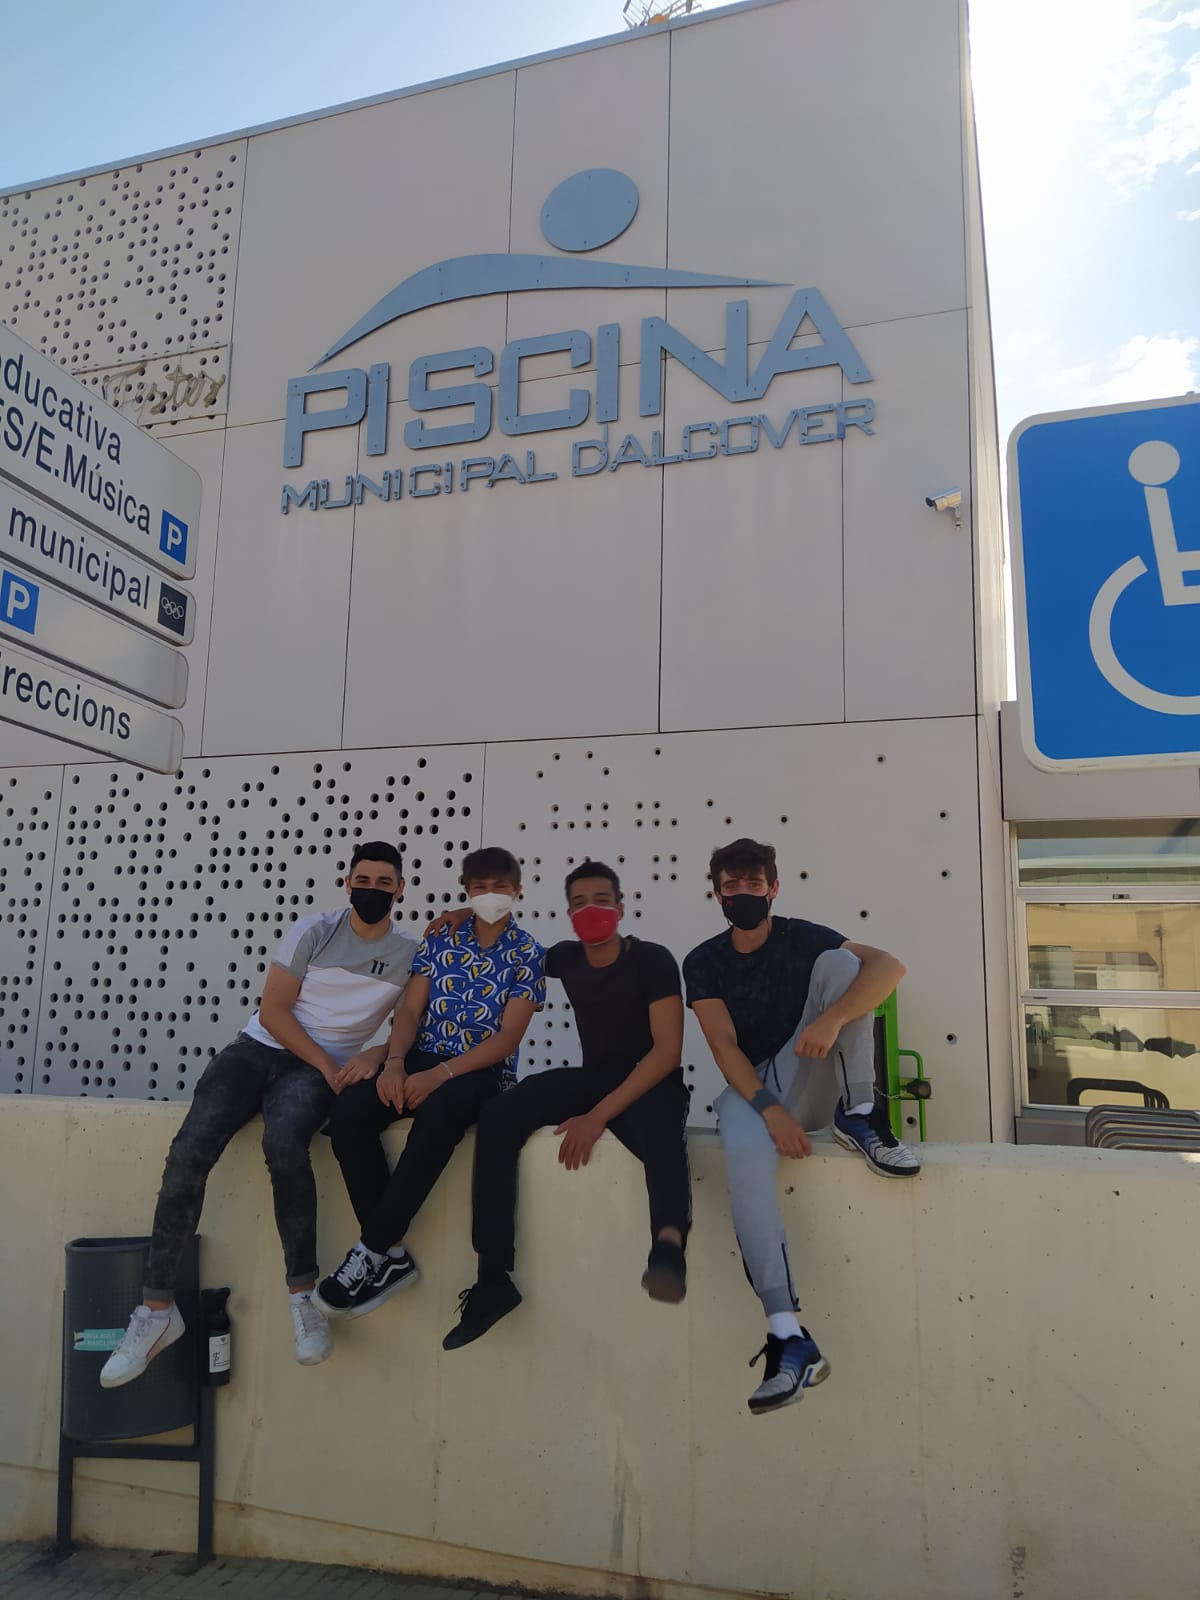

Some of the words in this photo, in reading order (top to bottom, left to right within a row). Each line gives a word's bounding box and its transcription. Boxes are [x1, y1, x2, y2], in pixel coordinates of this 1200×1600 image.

[0, 353, 121, 465] ducativa
[283, 286, 873, 468] PISCINA
[0, 398, 150, 535] S/E.Música
[166, 521, 183, 551] P
[281, 450, 558, 515] MUNICIPAL
[6, 580, 31, 619] P
[9, 507, 150, 610] municipal
[0, 655, 131, 740] reccions
